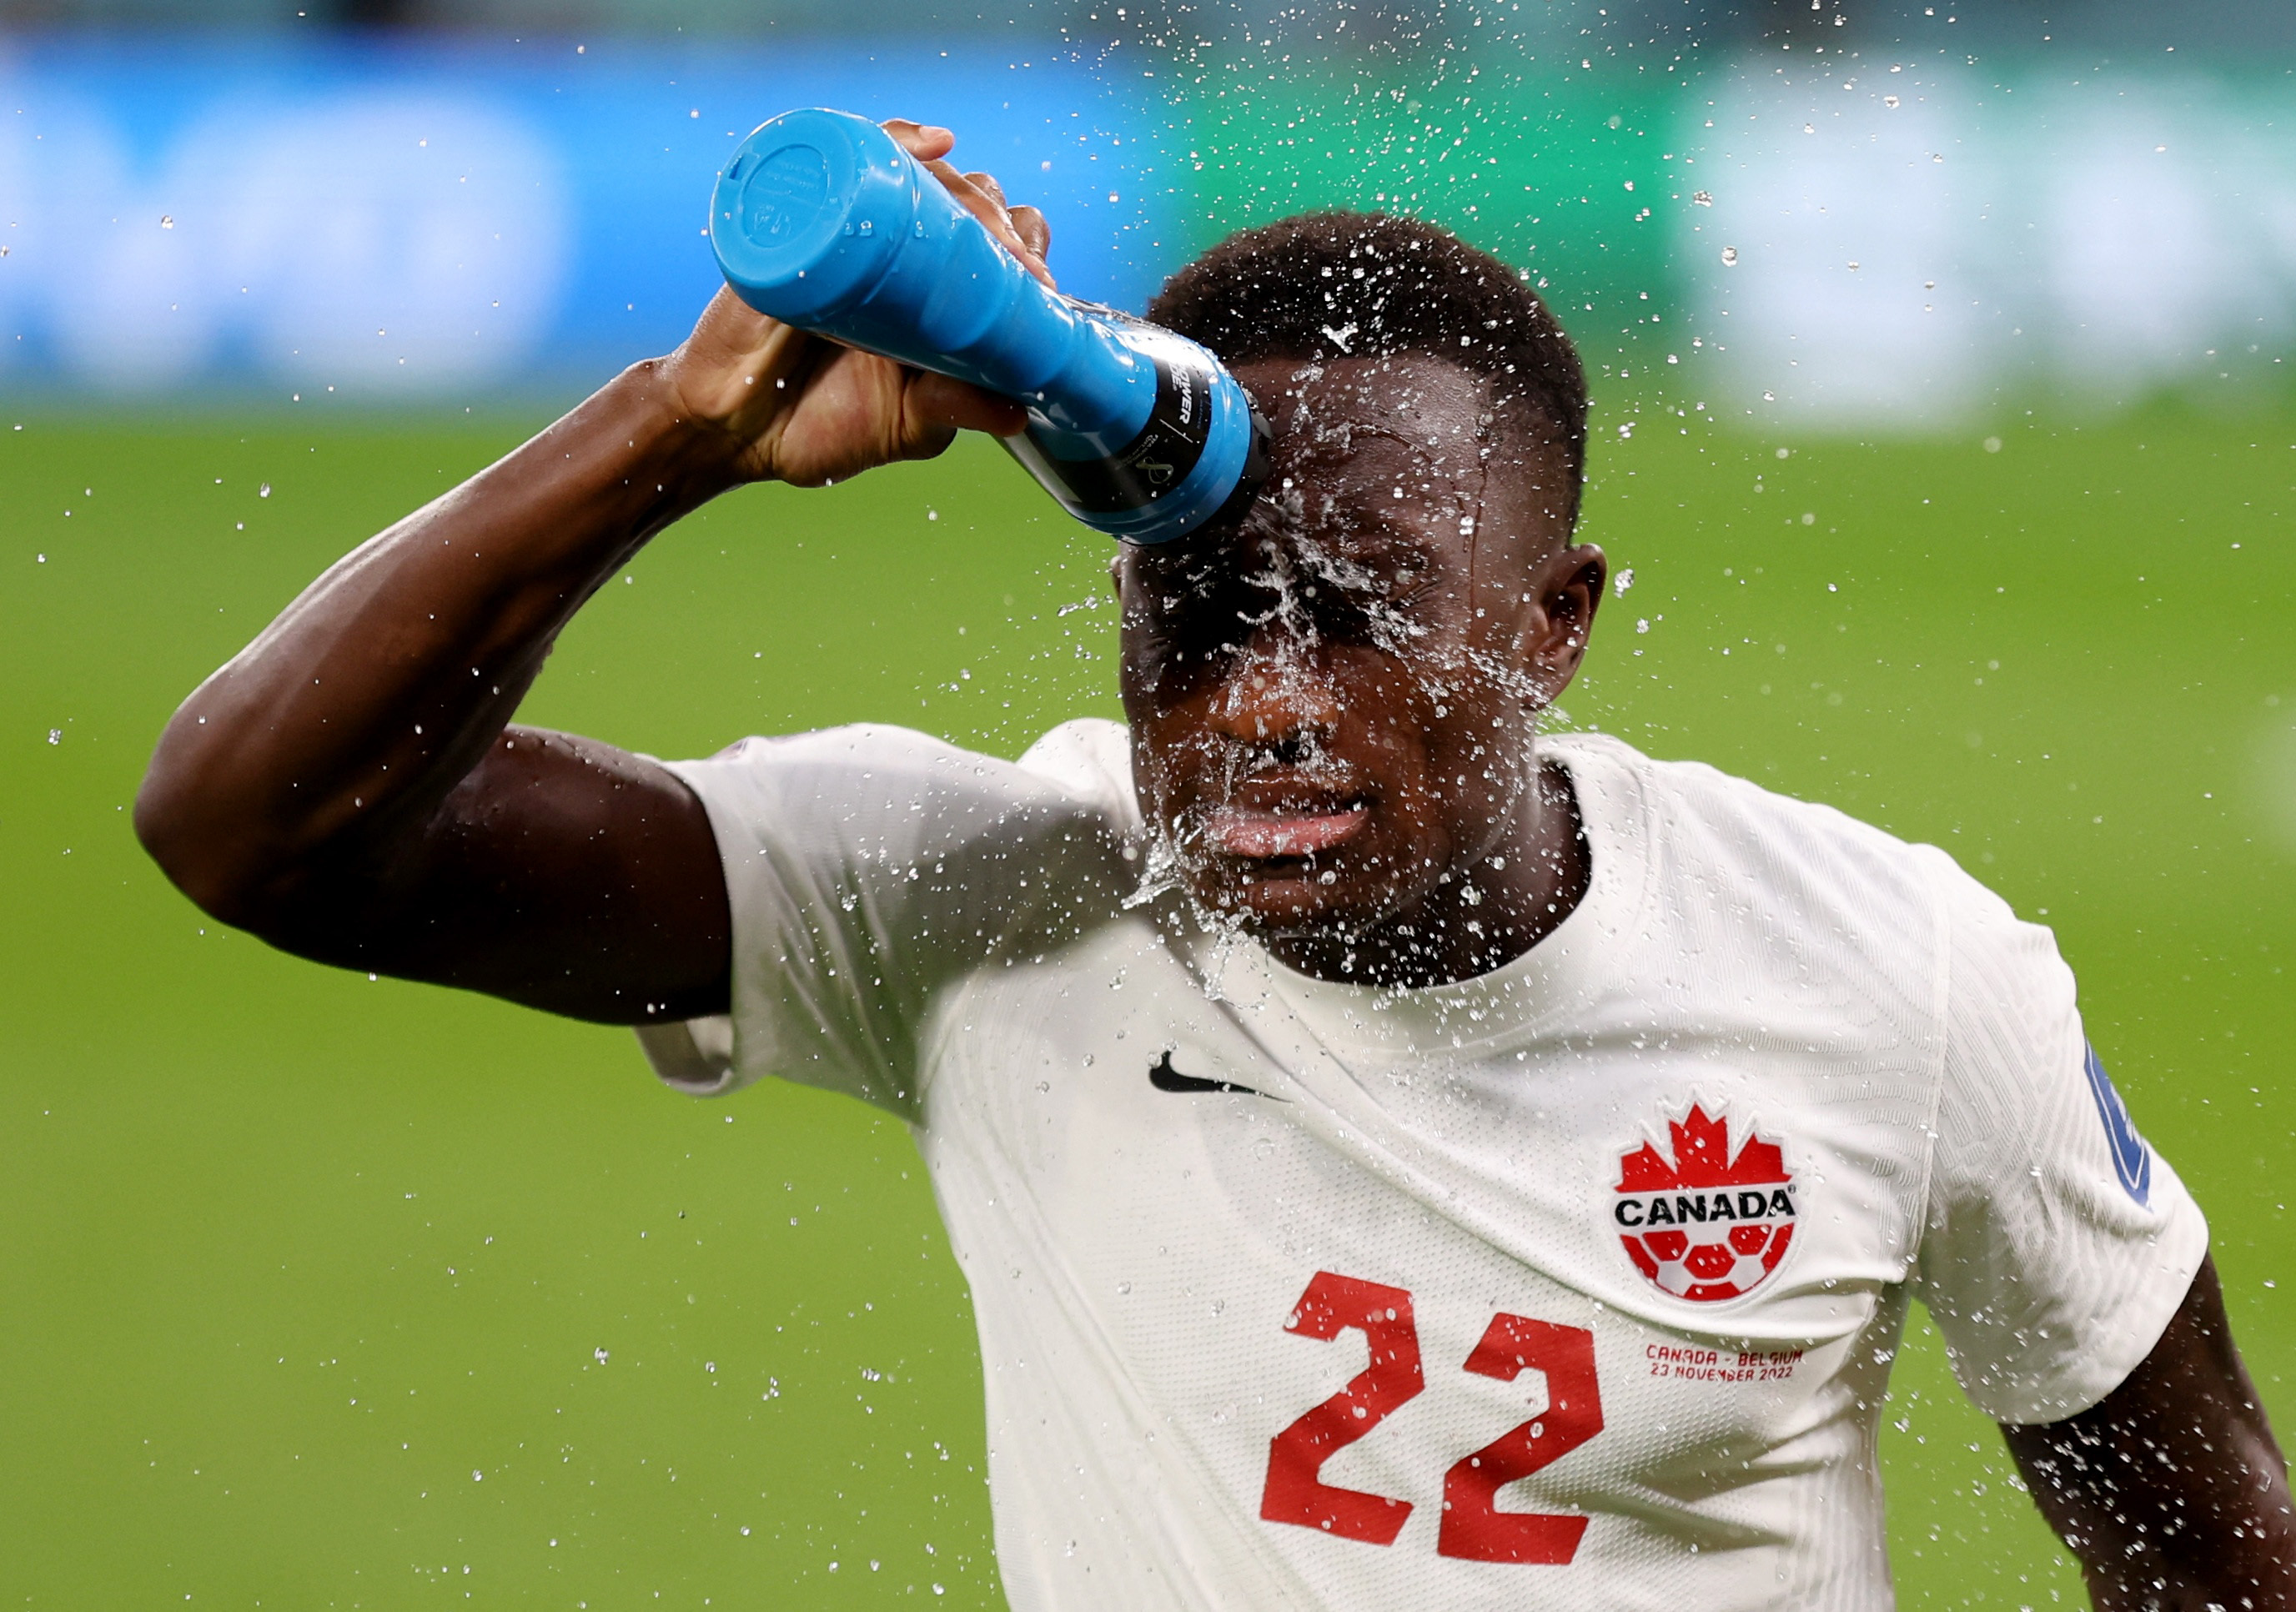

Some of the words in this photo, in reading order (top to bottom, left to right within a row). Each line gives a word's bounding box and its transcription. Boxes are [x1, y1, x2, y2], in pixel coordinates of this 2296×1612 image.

[1615, 1189, 1796, 1227] CANADA
[1646, 1344, 1718, 1366] CANADA
[1738, 1349, 1803, 1367] BELGIUM
[1650, 1362, 1669, 1377] 23
[1675, 1366, 1755, 1382] NOVEMBER
[1759, 1366, 1793, 1381] 2022
[1260, 1270, 1605, 1565] 22
